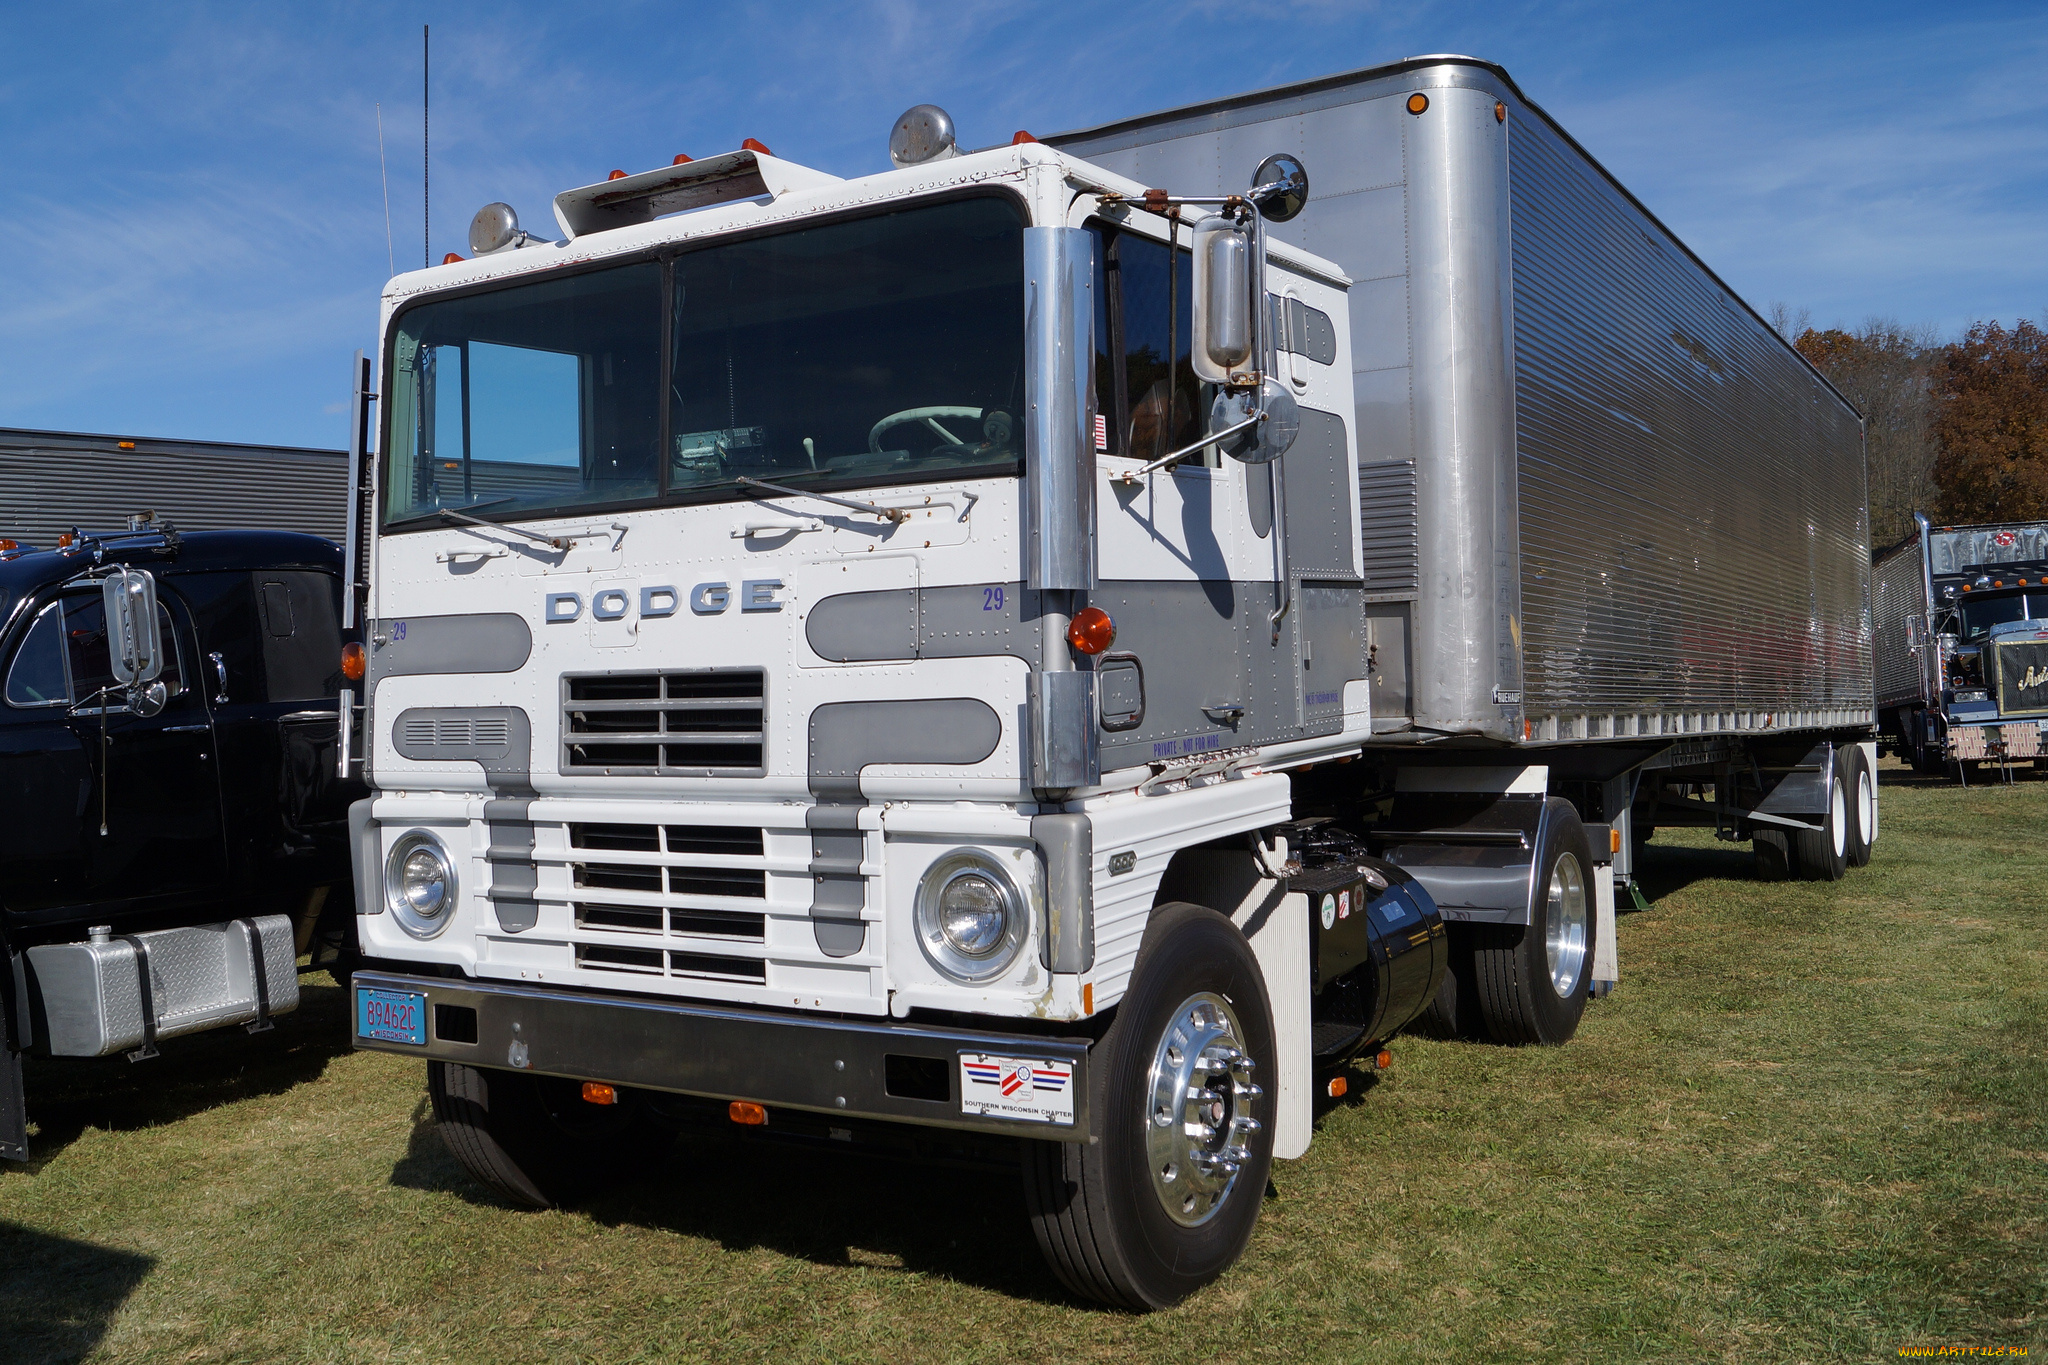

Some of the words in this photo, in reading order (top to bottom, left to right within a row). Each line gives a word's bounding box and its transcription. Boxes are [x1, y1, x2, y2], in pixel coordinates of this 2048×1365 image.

[546, 578, 786, 625] DODGE
[983, 587, 1004, 611] 29
[393, 621, 407, 641] 29
[1154, 740, 1177, 758] PRIVATE
[1183, 738, 1193, 753] NOT
[1195, 736, 1206, 751] FOR
[1207, 734, 1219, 748] HIRE
[376, 992, 406, 1002] COLLECTOR
[367, 1000, 416, 1031] 89462C
[374, 1029, 409, 1040] WISCONSIN
[964, 1100, 999, 1110] SOUTHERN
[1001, 1104, 1039, 1114] WISCONSIN
[1041, 1109, 1072, 1118] CHAPTER
